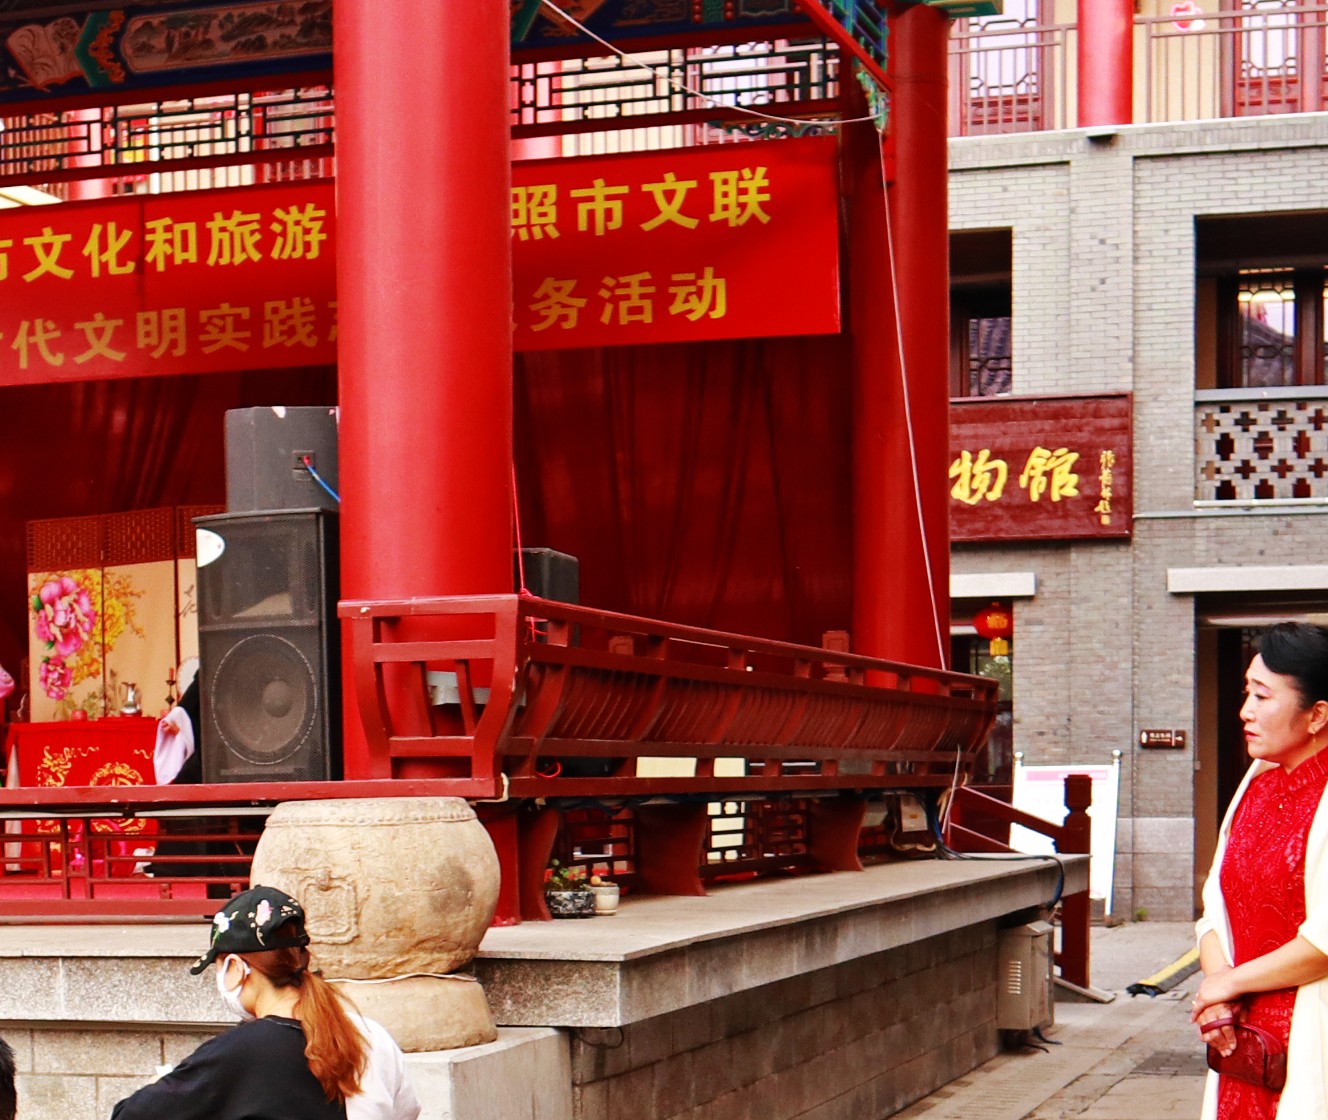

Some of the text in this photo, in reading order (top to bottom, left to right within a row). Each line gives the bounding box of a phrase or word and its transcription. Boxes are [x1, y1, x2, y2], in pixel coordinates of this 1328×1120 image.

[511, 166, 771, 241] 照市文联
[511, 266, 727, 332] 务活动
